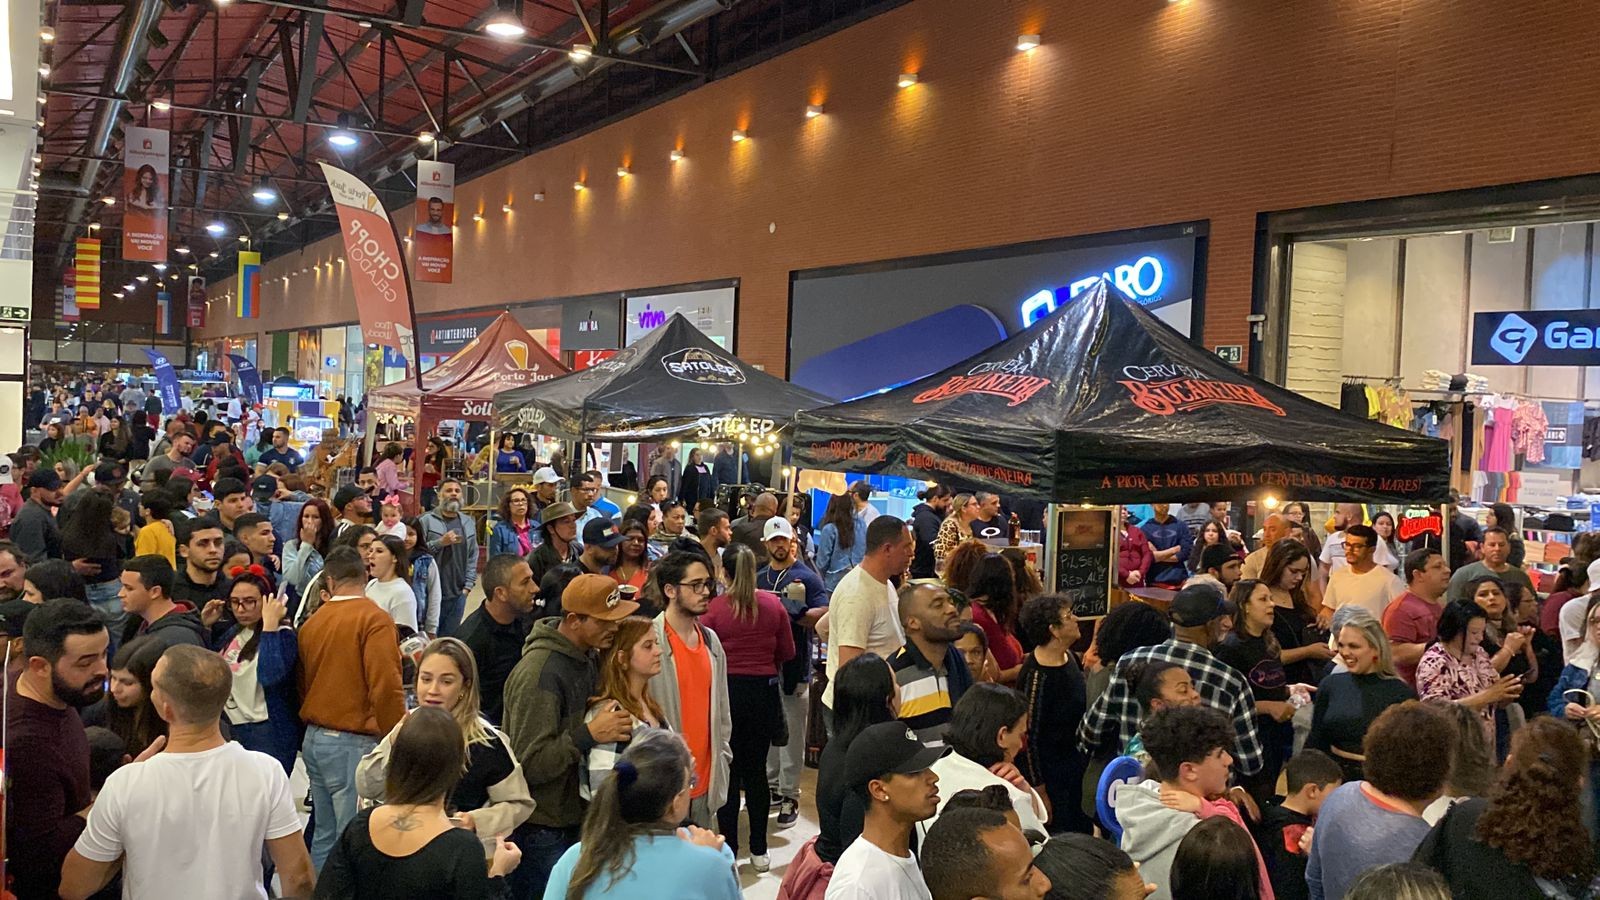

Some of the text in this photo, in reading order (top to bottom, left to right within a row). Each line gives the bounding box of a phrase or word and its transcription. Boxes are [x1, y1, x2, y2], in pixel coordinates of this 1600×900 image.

[638, 303, 666, 329] vivo
[668, 361, 737, 377] SATOLEP
[1116, 379, 1287, 417] BUCANEIRA
[1101, 471, 1422, 493] A PIOR E MAIS TEMIDA CERVEJA DOS SETES MARES!
